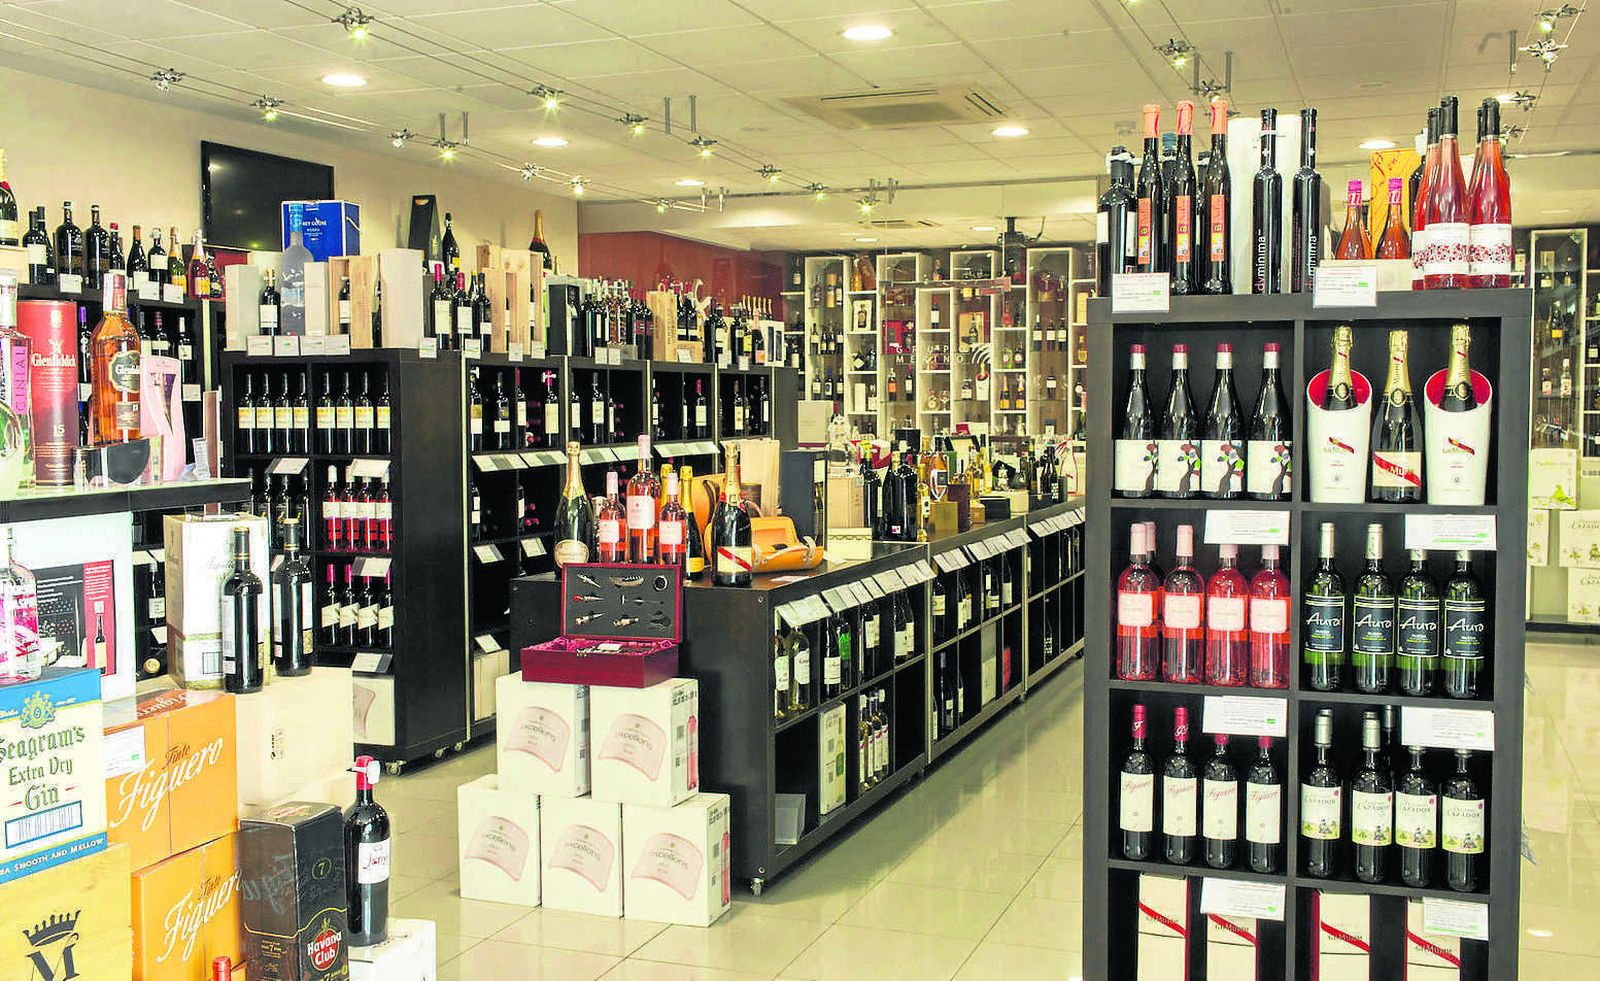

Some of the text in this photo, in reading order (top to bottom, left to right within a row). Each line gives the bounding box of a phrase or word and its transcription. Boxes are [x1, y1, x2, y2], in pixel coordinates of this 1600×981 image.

[31, 353, 76, 367] Glenfiddich
[53, 424, 66, 437] 15
[8, 756, 73, 787] Extra Dry
[110, 737, 224, 831] Figuero
[24, 783, 60, 811] Gin
[14, 855, 48, 872] SMOOTH
[51, 849, 67, 861] AND
[307, 931, 342, 956] Havana
[314, 946, 336, 966] Club
